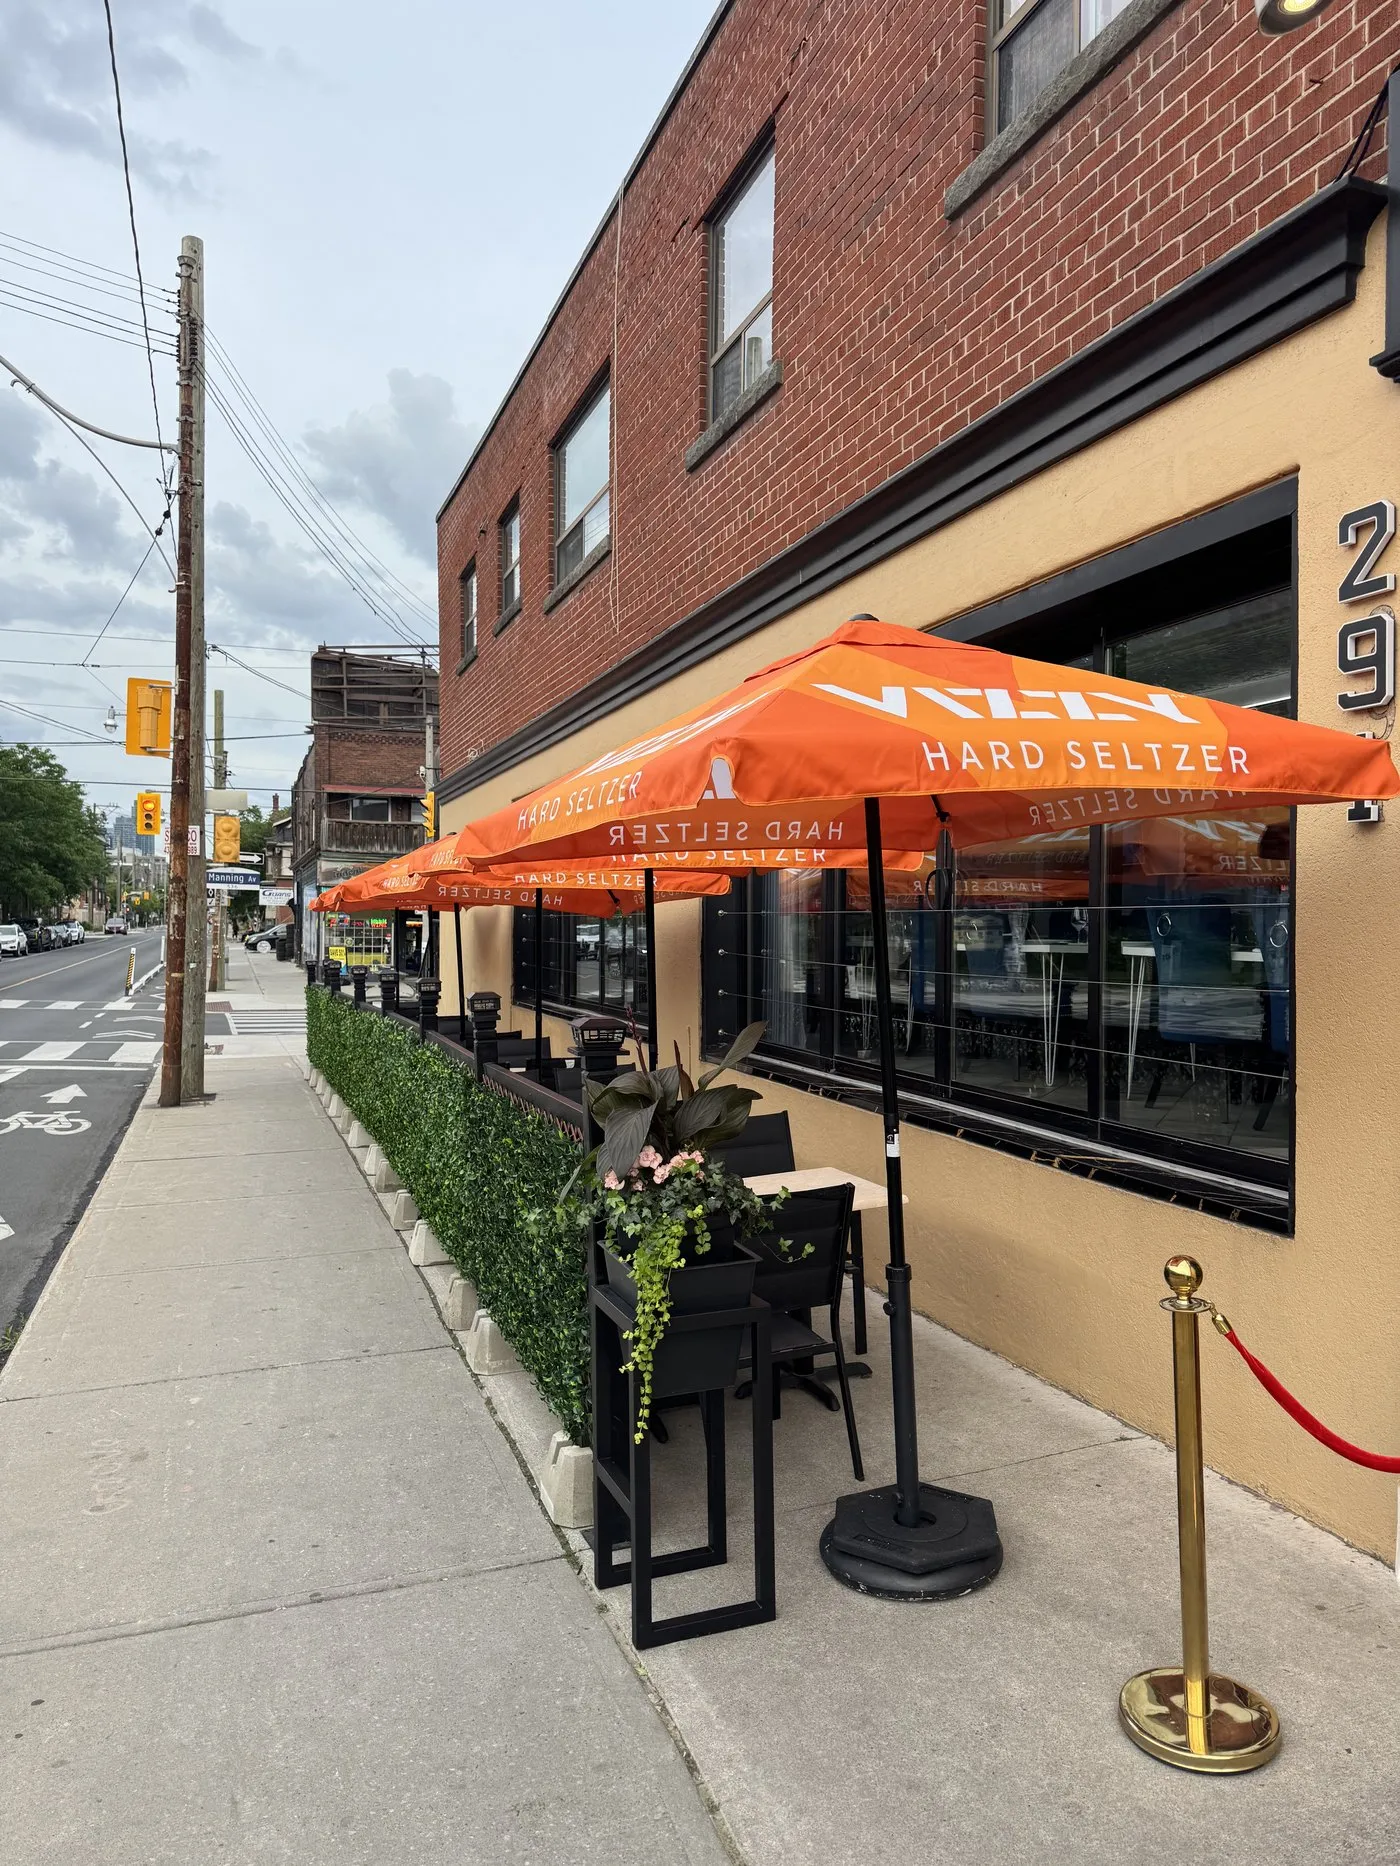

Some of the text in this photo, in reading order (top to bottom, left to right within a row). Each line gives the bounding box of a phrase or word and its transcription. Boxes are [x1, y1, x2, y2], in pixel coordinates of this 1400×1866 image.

[922, 740, 1250, 774] HARD SELTZER
[517, 770, 643, 832] HARD SELTZER
[208, 873, 244, 884] Manning
